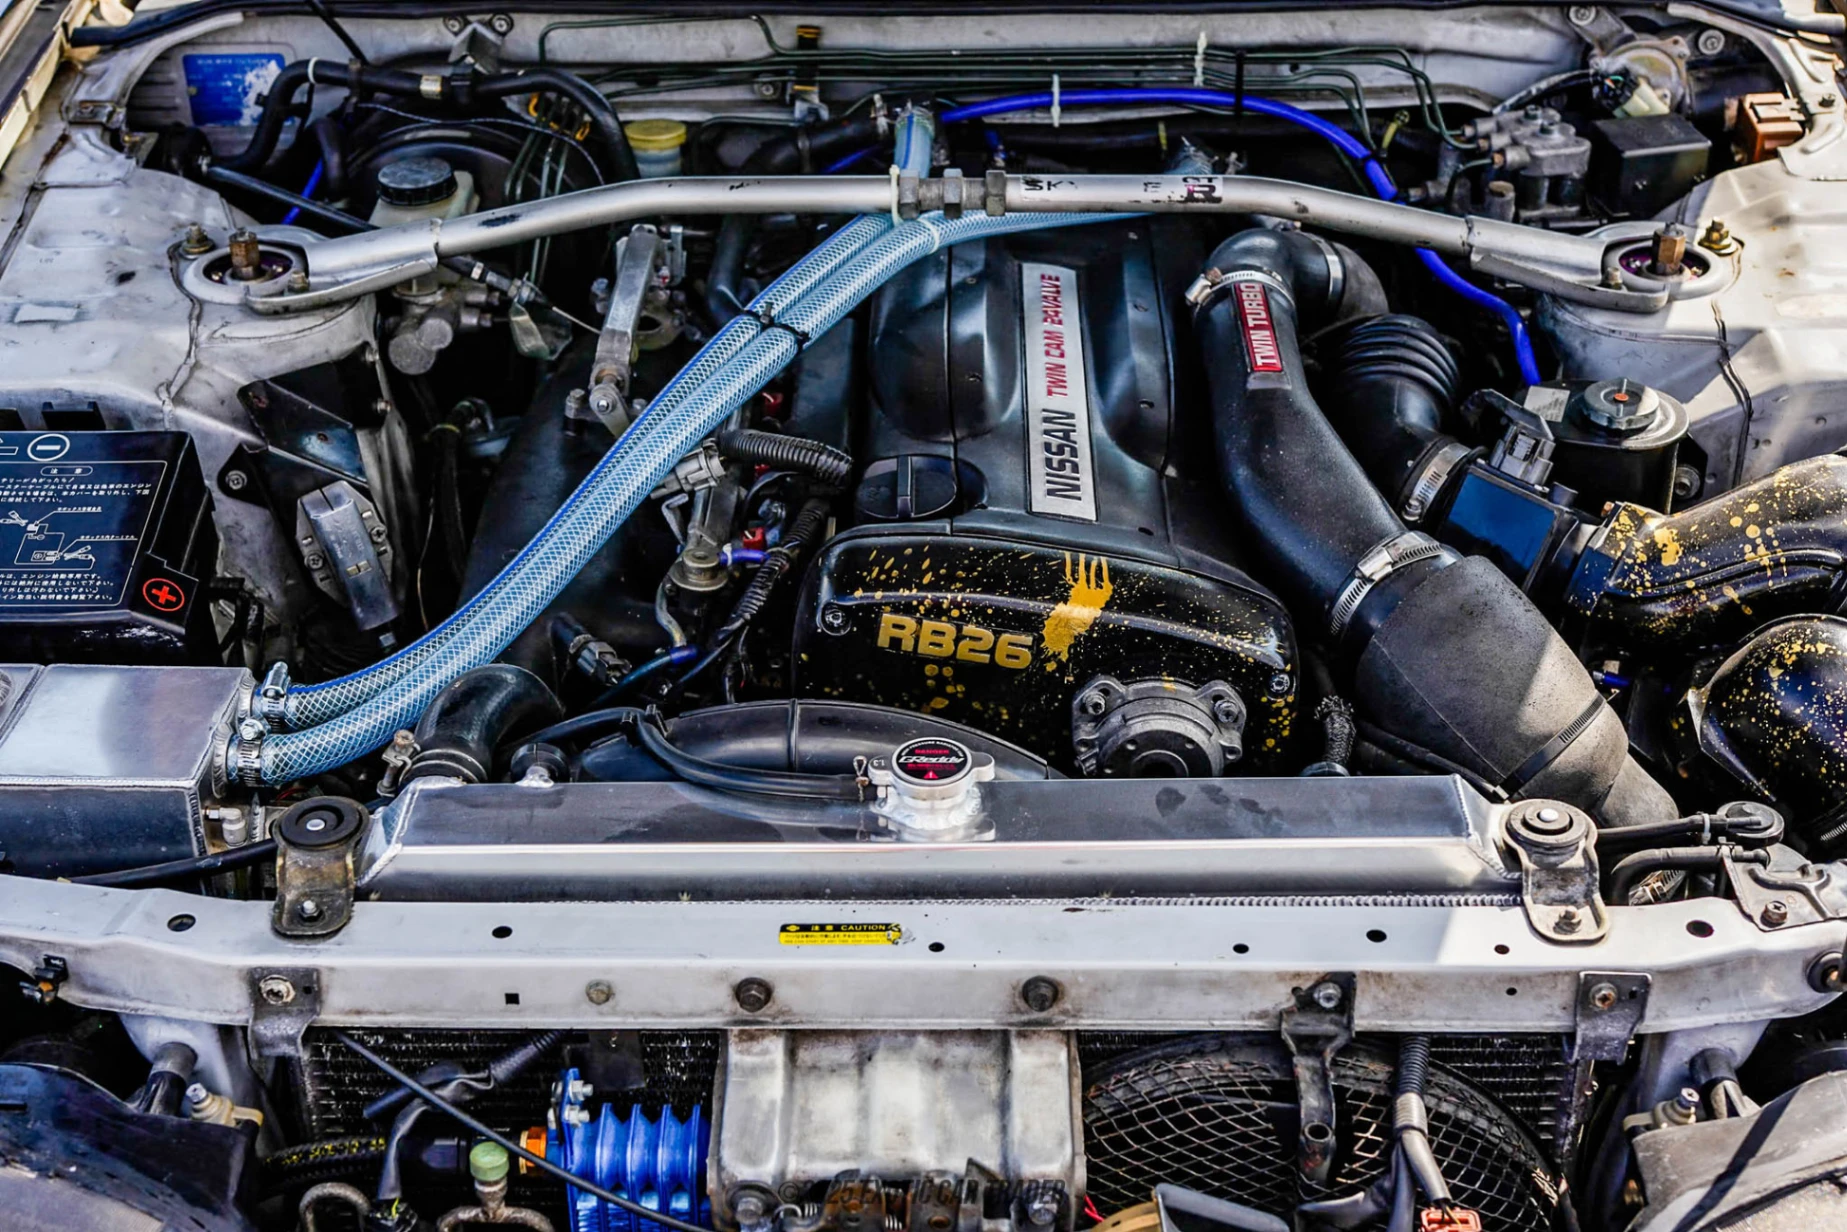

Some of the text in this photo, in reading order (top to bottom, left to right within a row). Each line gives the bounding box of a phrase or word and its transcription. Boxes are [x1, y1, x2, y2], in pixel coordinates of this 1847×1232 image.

[1043, 329, 1066, 359] CAM
[1240, 282, 1278, 366] TWIN TURBO
[1045, 362, 1068, 397] TWIN
[1041, 408, 1082, 501] NISSAN
[877, 613, 1033, 669] RB26
